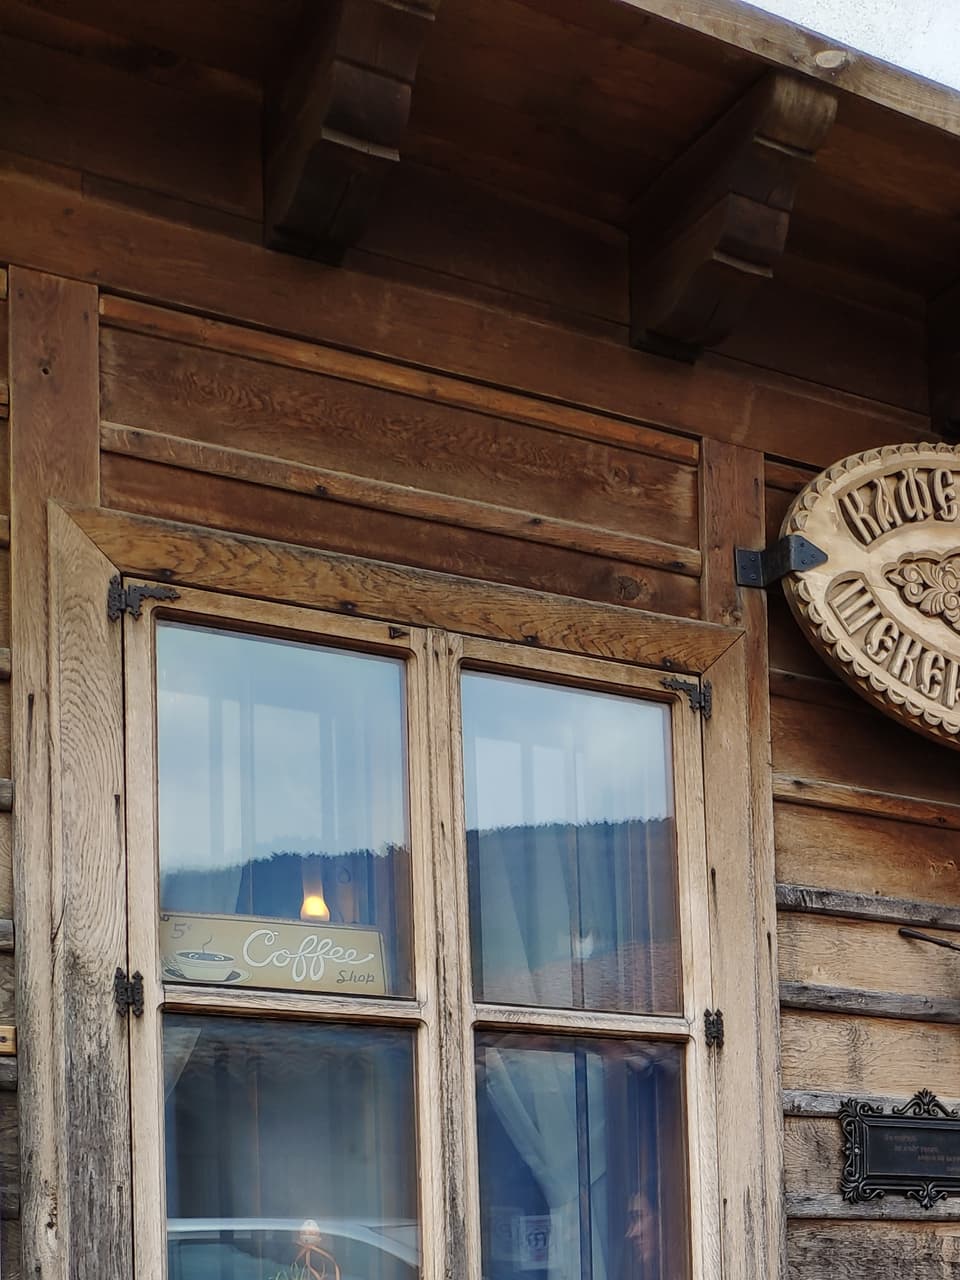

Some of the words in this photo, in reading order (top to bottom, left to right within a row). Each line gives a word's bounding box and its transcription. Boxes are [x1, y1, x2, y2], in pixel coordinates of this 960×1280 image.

[839, 467, 959, 545] КАФЕ
[243, 929, 375, 982] Coffee
[336, 969, 376, 984] Shop
